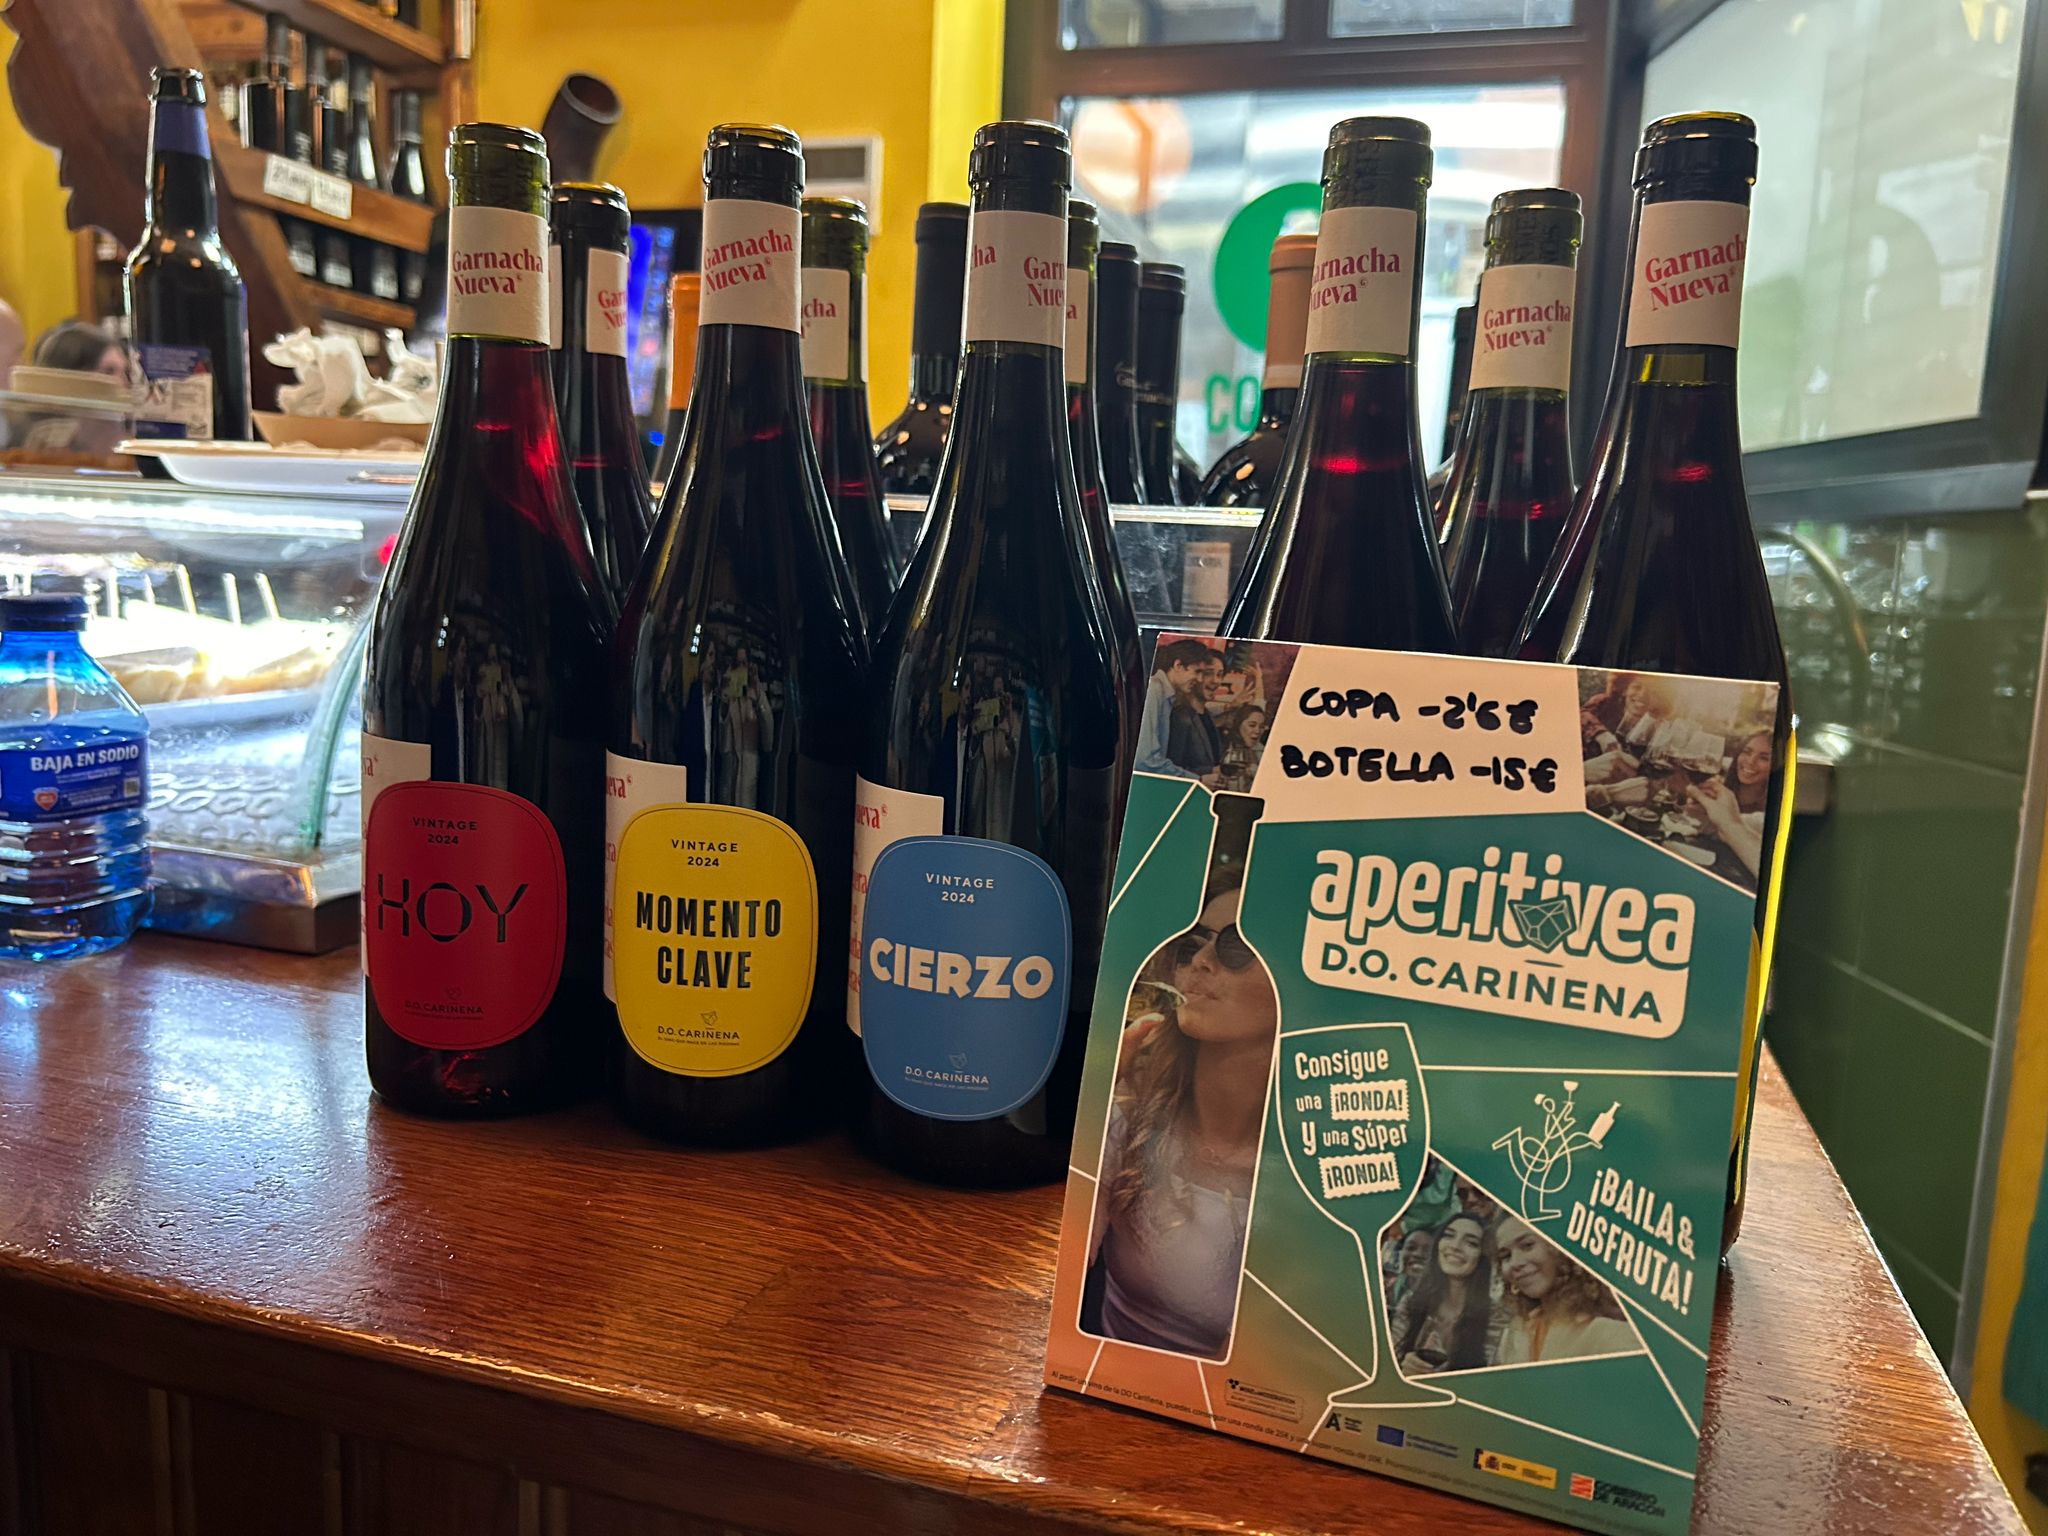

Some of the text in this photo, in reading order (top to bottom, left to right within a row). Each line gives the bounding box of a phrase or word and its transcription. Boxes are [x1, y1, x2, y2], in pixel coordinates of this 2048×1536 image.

[453, 249, 544, 273] Garnacha
[704, 229, 793, 270] Garnacha
[1312, 247, 1401, 283] arnacha
[1645, 234, 1747, 283] Garnach
[1484, 300, 1571, 330] Garnacha
[1299, 686, 1400, 722] COPA
[30, 744, 139, 774] BAJA EN SODIO
[1280, 744, 1455, 783] BOTELLA
[413, 816, 478, 831] VINTAGE
[428, 833, 460, 845] 2024
[671, 838, 739, 853] VINTAGE
[687, 856, 720, 868] 2024
[925, 872, 996, 890] VINTAGE
[377, 873, 529, 943] HOY
[941, 891, 976, 904] 2024
[1309, 846, 1697, 965] aperitivea
[636, 891, 782, 938] MOMENTO
[657, 946, 752, 989] CLAVE
[869, 937, 1055, 1000] CIERZO
[1320, 942, 1399, 982] D.O.
[1295, 1049, 1390, 1080] Consigue
[1296, 1089, 1403, 1113] una ¡RONDA!
[1322, 1130, 1349, 1147] una
[1326, 1161, 1395, 1190] ¡RONDA!
[1567, 1201, 1694, 1316] DISFRUTA!
